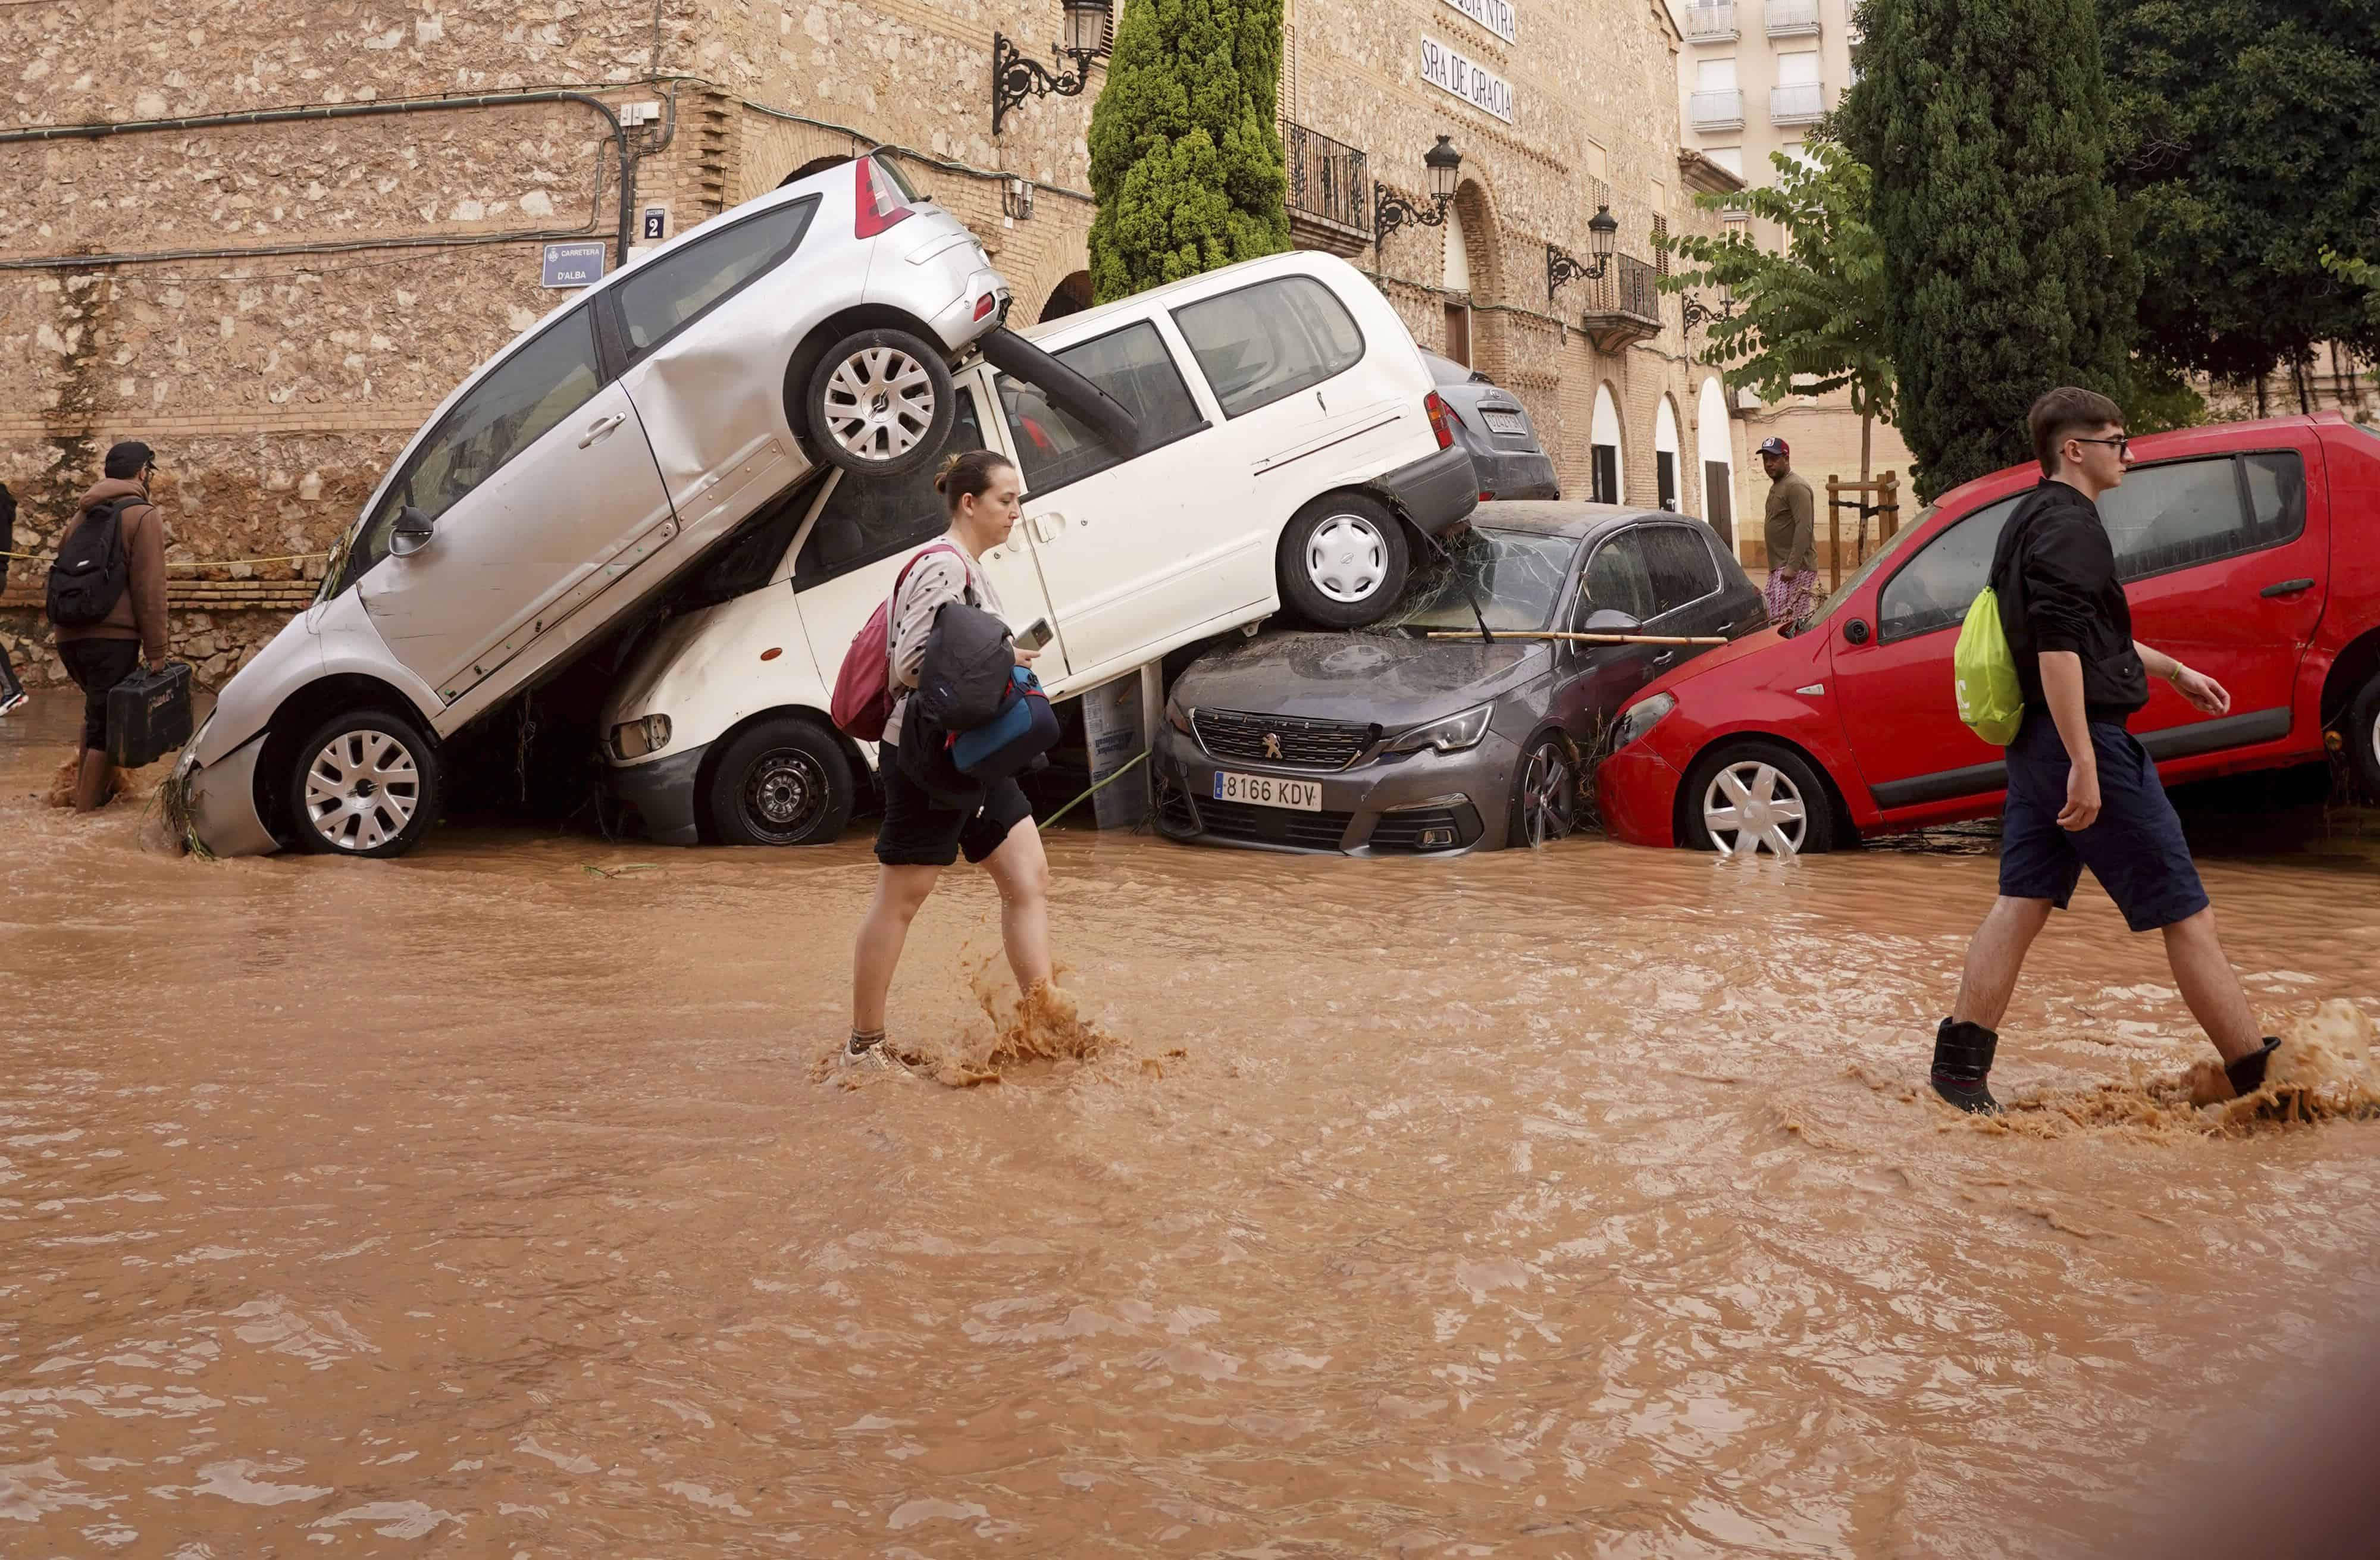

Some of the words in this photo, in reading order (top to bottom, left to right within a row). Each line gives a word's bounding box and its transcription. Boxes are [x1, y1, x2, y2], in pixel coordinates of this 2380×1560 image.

[1486, 0, 1515, 40] NTRA
[1422, 40, 1447, 86] SRA
[1452, 55, 1467, 96] DE
[1471, 68, 1512, 120] GRACIA
[649, 218, 658, 237] 2
[561, 249, 600, 257] CARRETERA
[558, 271, 586, 280] D'ALBA
[1227, 776, 1271, 801] 8166
[1279, 782, 1314, 806] KDV
